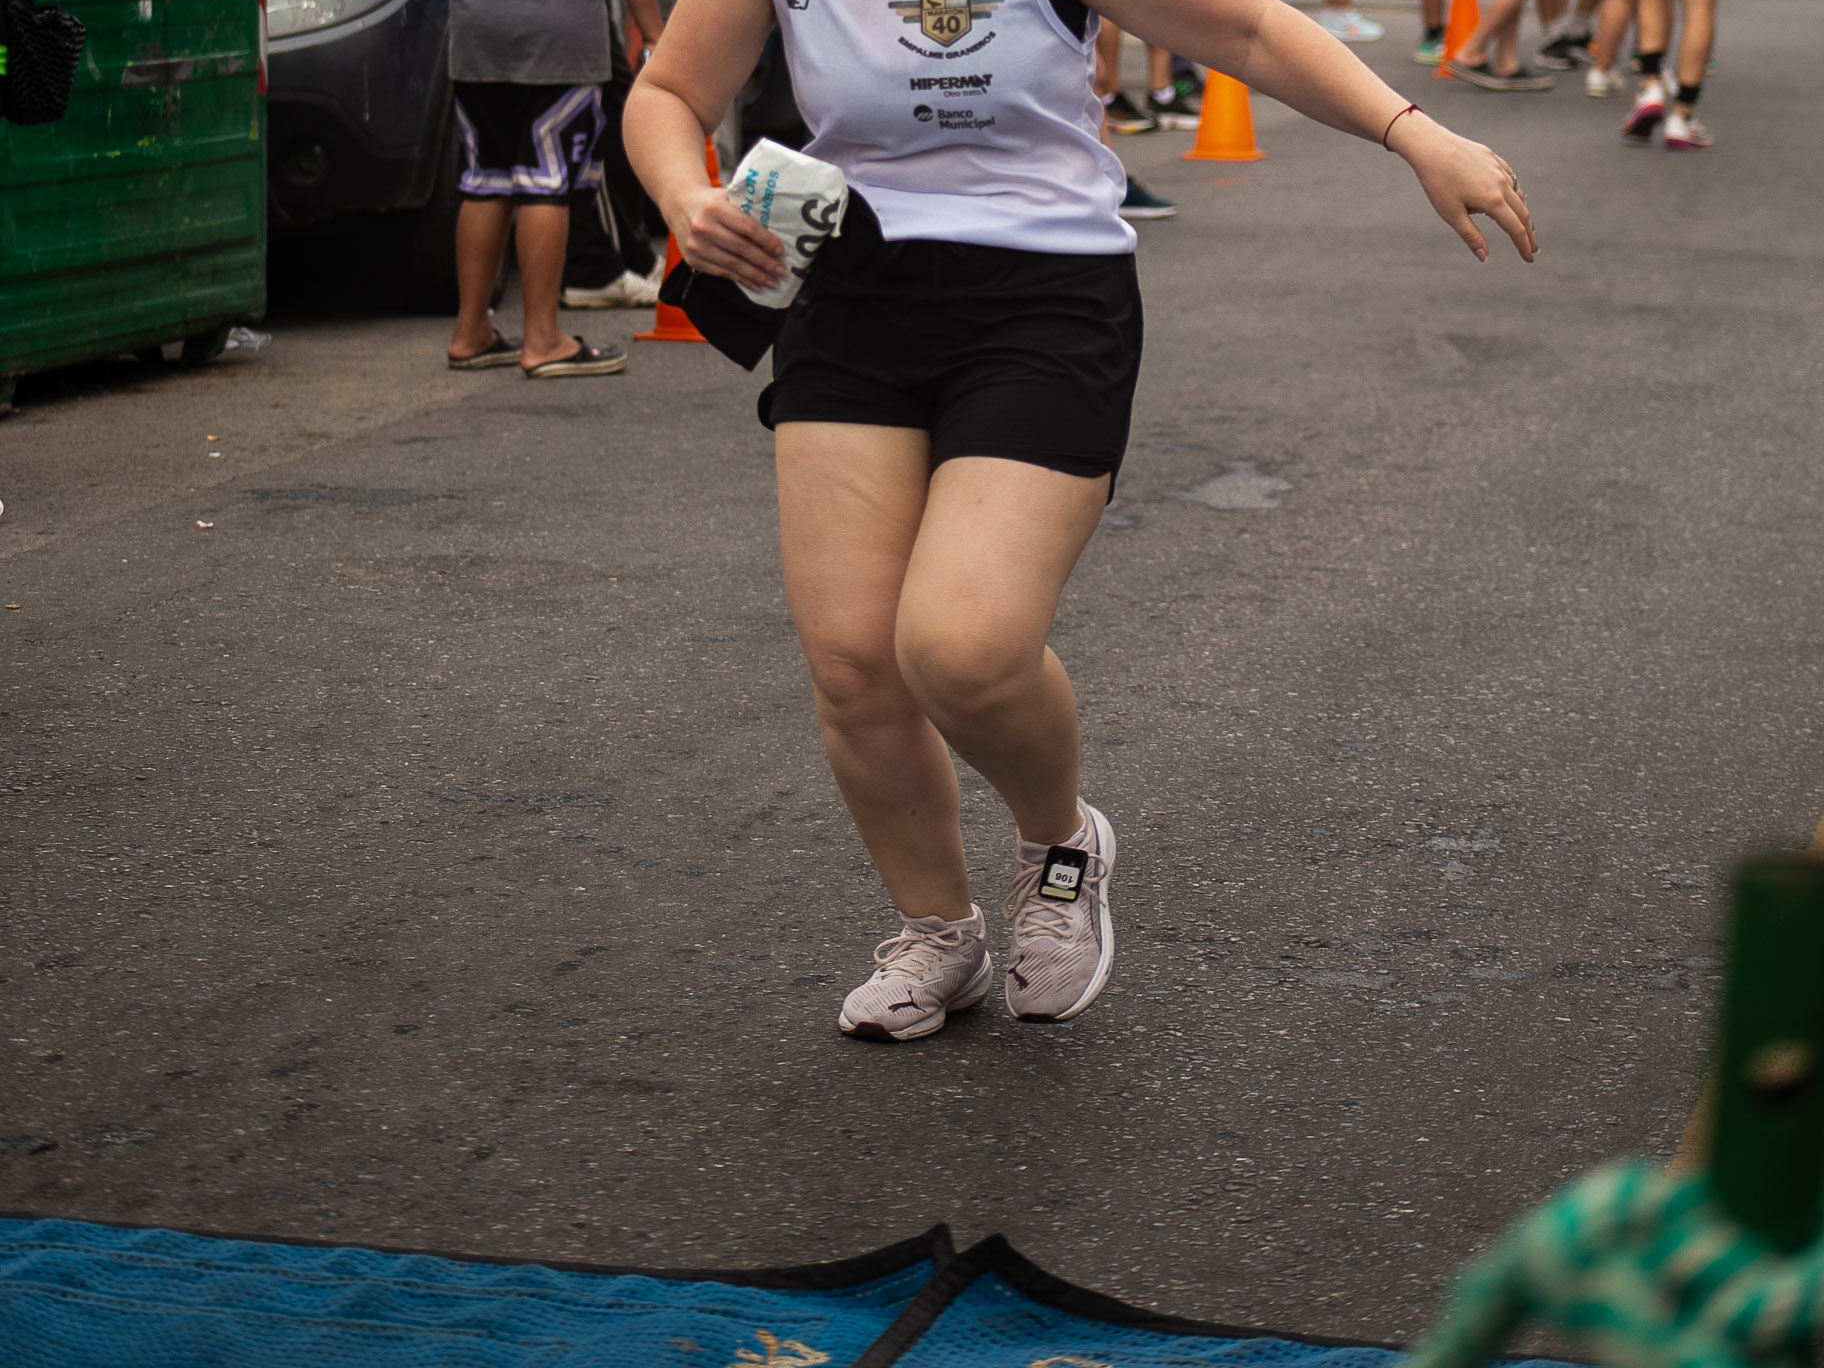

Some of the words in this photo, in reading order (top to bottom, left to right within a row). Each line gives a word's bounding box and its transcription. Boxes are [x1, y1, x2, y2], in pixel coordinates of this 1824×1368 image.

[932, 16, 960, 34] 40
[898, 36, 944, 59] EMPALME
[945, 31, 996, 59] GRANEROS
[937, 109, 973, 120] Banco
[939, 116, 995, 130] Municipal
[1055, 872, 1073, 884] 106
